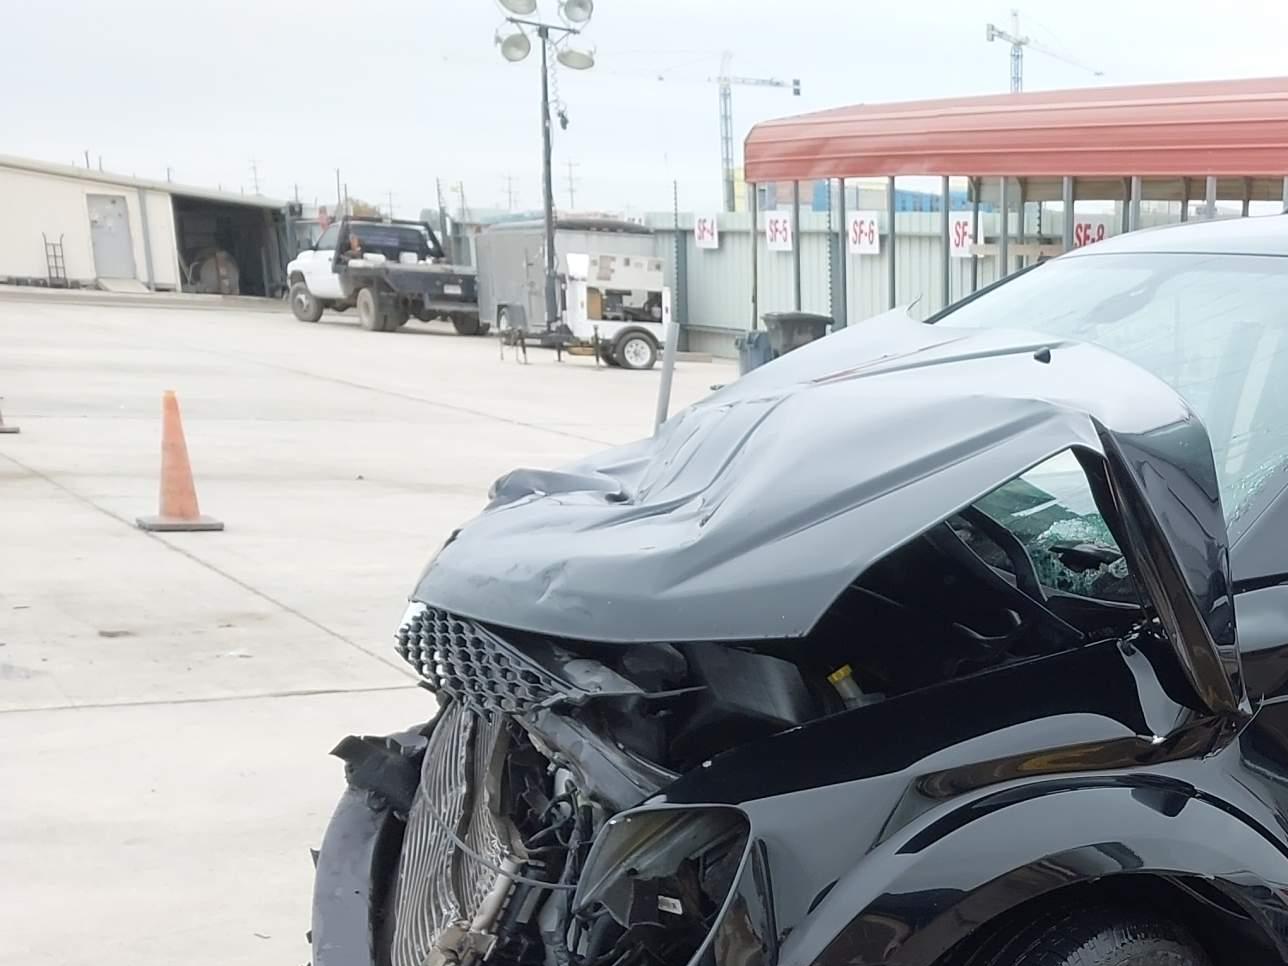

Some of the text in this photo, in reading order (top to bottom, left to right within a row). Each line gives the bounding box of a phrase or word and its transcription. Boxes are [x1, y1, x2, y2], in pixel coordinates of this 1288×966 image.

[768, 219, 788, 242] SF-5
[852, 220, 874, 245] SF-6
[954, 220, 976, 248] SF-
